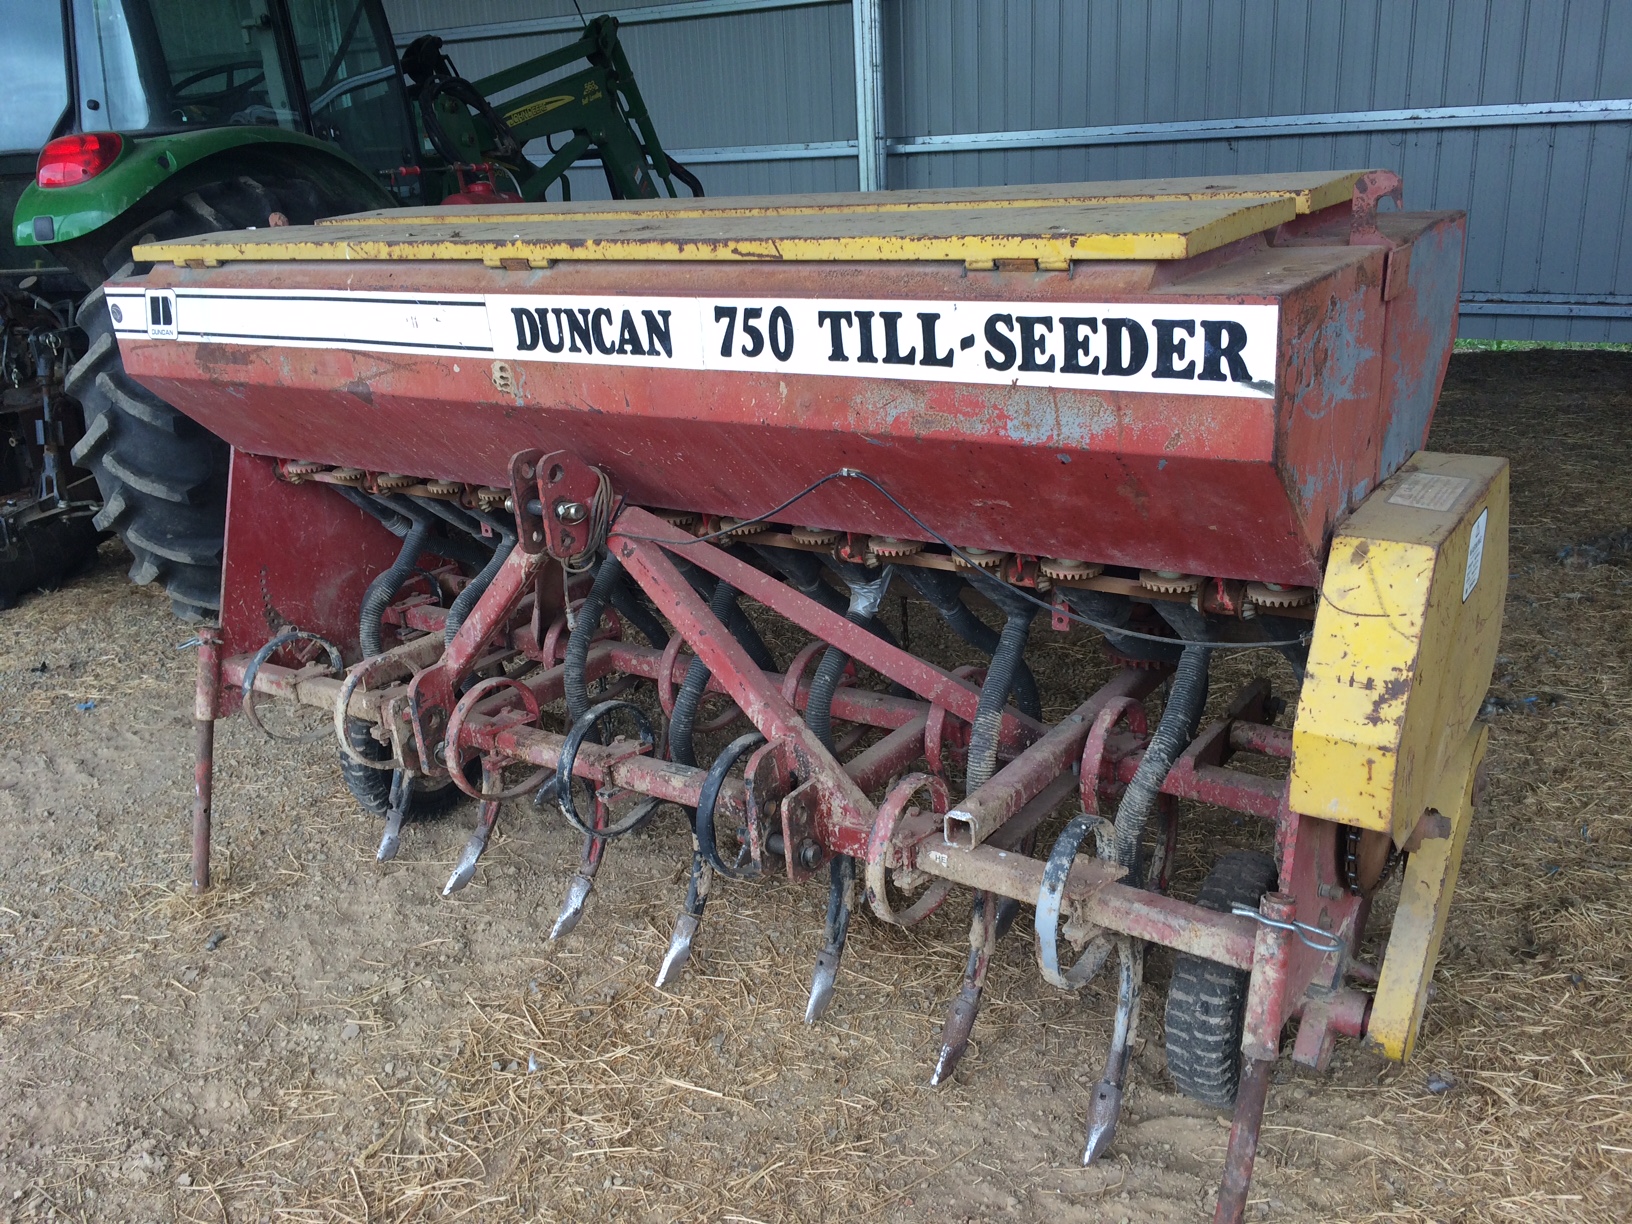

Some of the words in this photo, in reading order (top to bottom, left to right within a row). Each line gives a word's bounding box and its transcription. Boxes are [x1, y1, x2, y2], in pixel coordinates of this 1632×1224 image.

[509, 108, 530, 126] JOHN
[527, 101, 549, 119] DEERE
[151, 328, 174, 336] DUNCAN
[510, 307, 673, 359] DUNCAN
[714, 305, 794, 362] 750
[817, 310, 1253, 383] TILL-SEEDER
